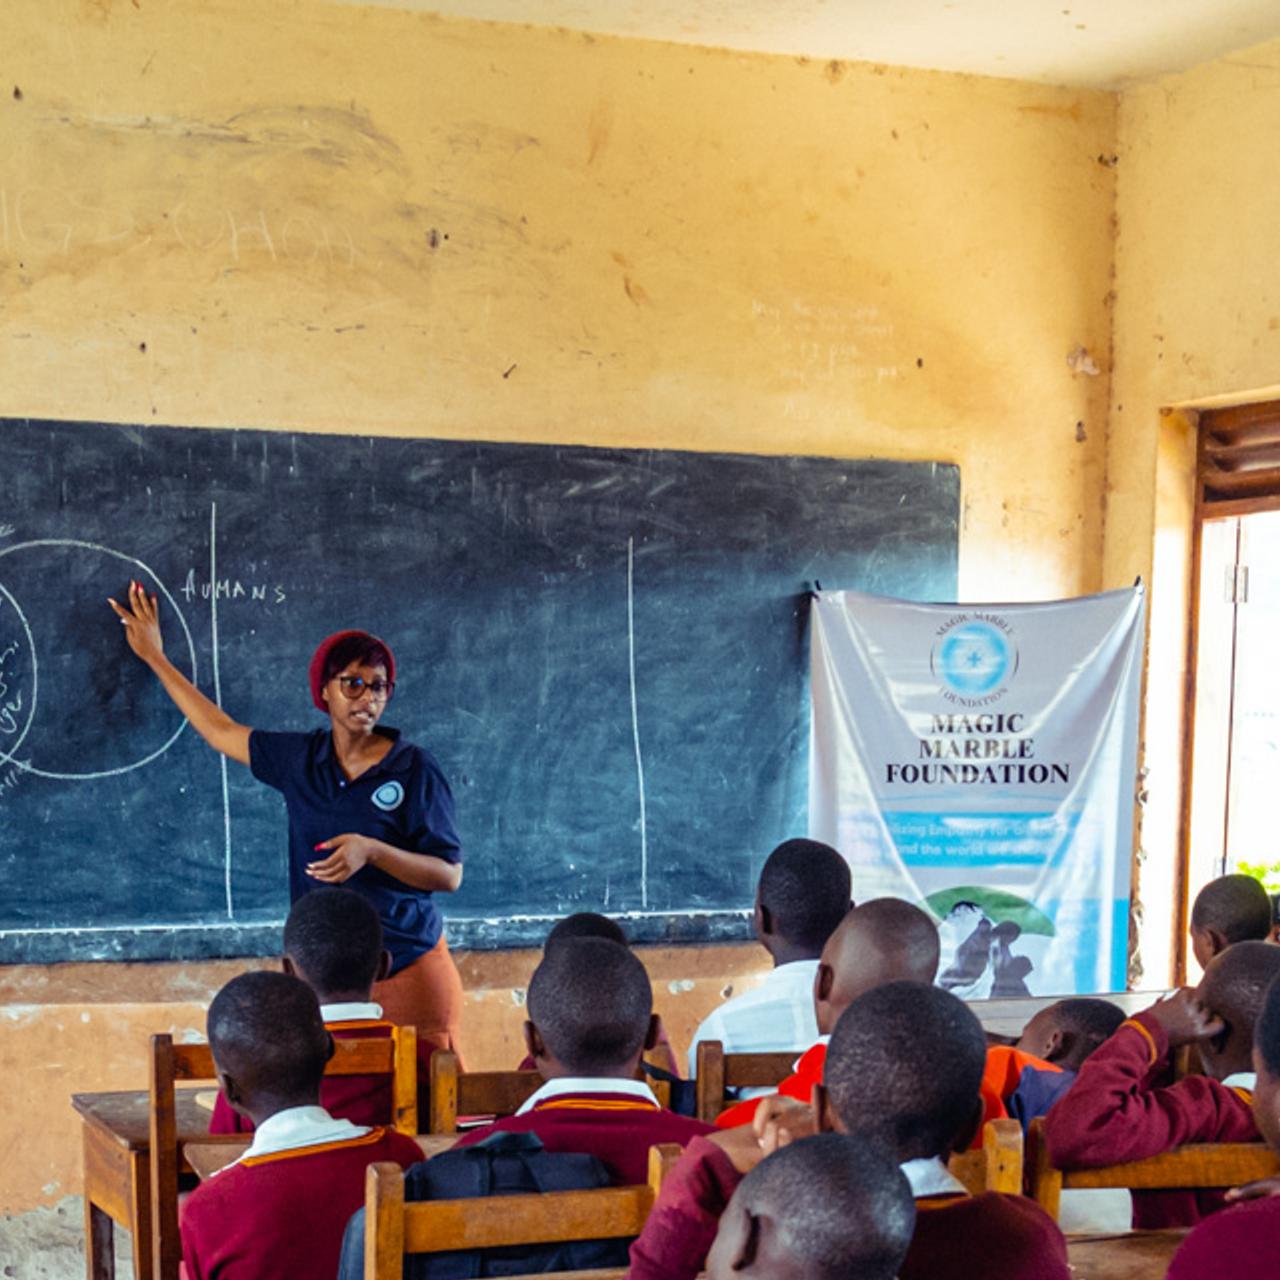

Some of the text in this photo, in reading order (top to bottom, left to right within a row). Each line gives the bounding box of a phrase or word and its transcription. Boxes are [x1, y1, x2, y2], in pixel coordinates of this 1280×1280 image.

[930, 713, 1024, 734] MAGIC
[919, 738, 1035, 760] MARBLE
[885, 763, 1070, 784] FOUNDATION
